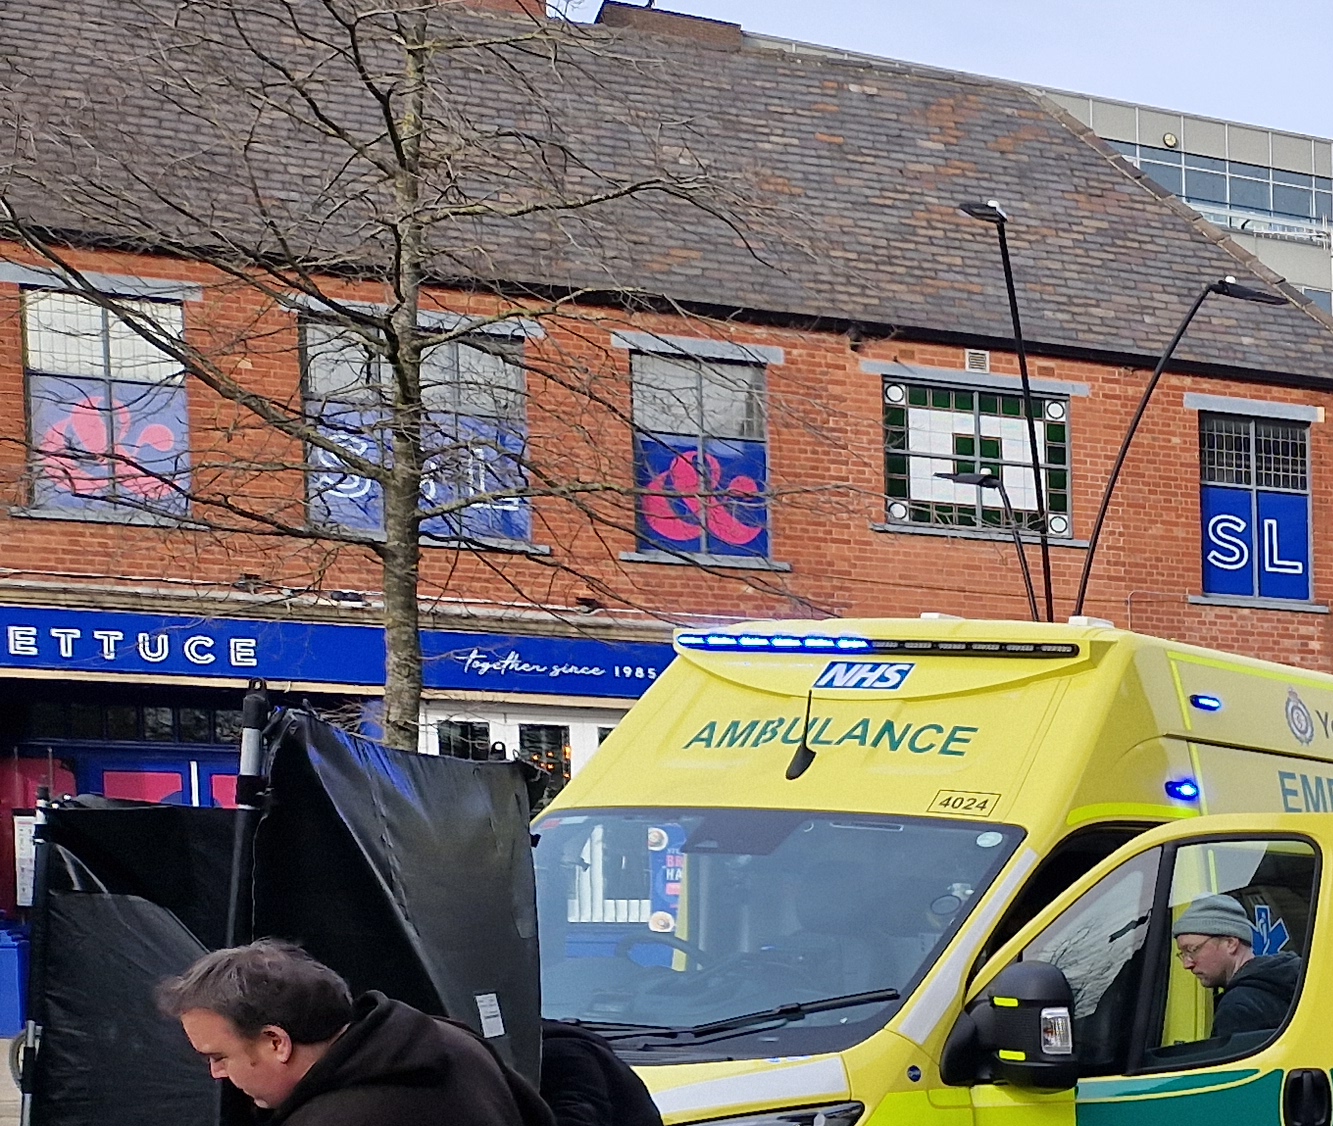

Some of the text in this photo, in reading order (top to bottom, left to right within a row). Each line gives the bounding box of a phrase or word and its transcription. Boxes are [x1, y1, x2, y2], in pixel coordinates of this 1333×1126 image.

[550, 663, 606, 677] since
[614, 666, 658, 679] 1985
[816, 662, 913, 688] NHS
[683, 717, 980, 757] AMBULANCE
[939, 796, 990, 812] 4024
